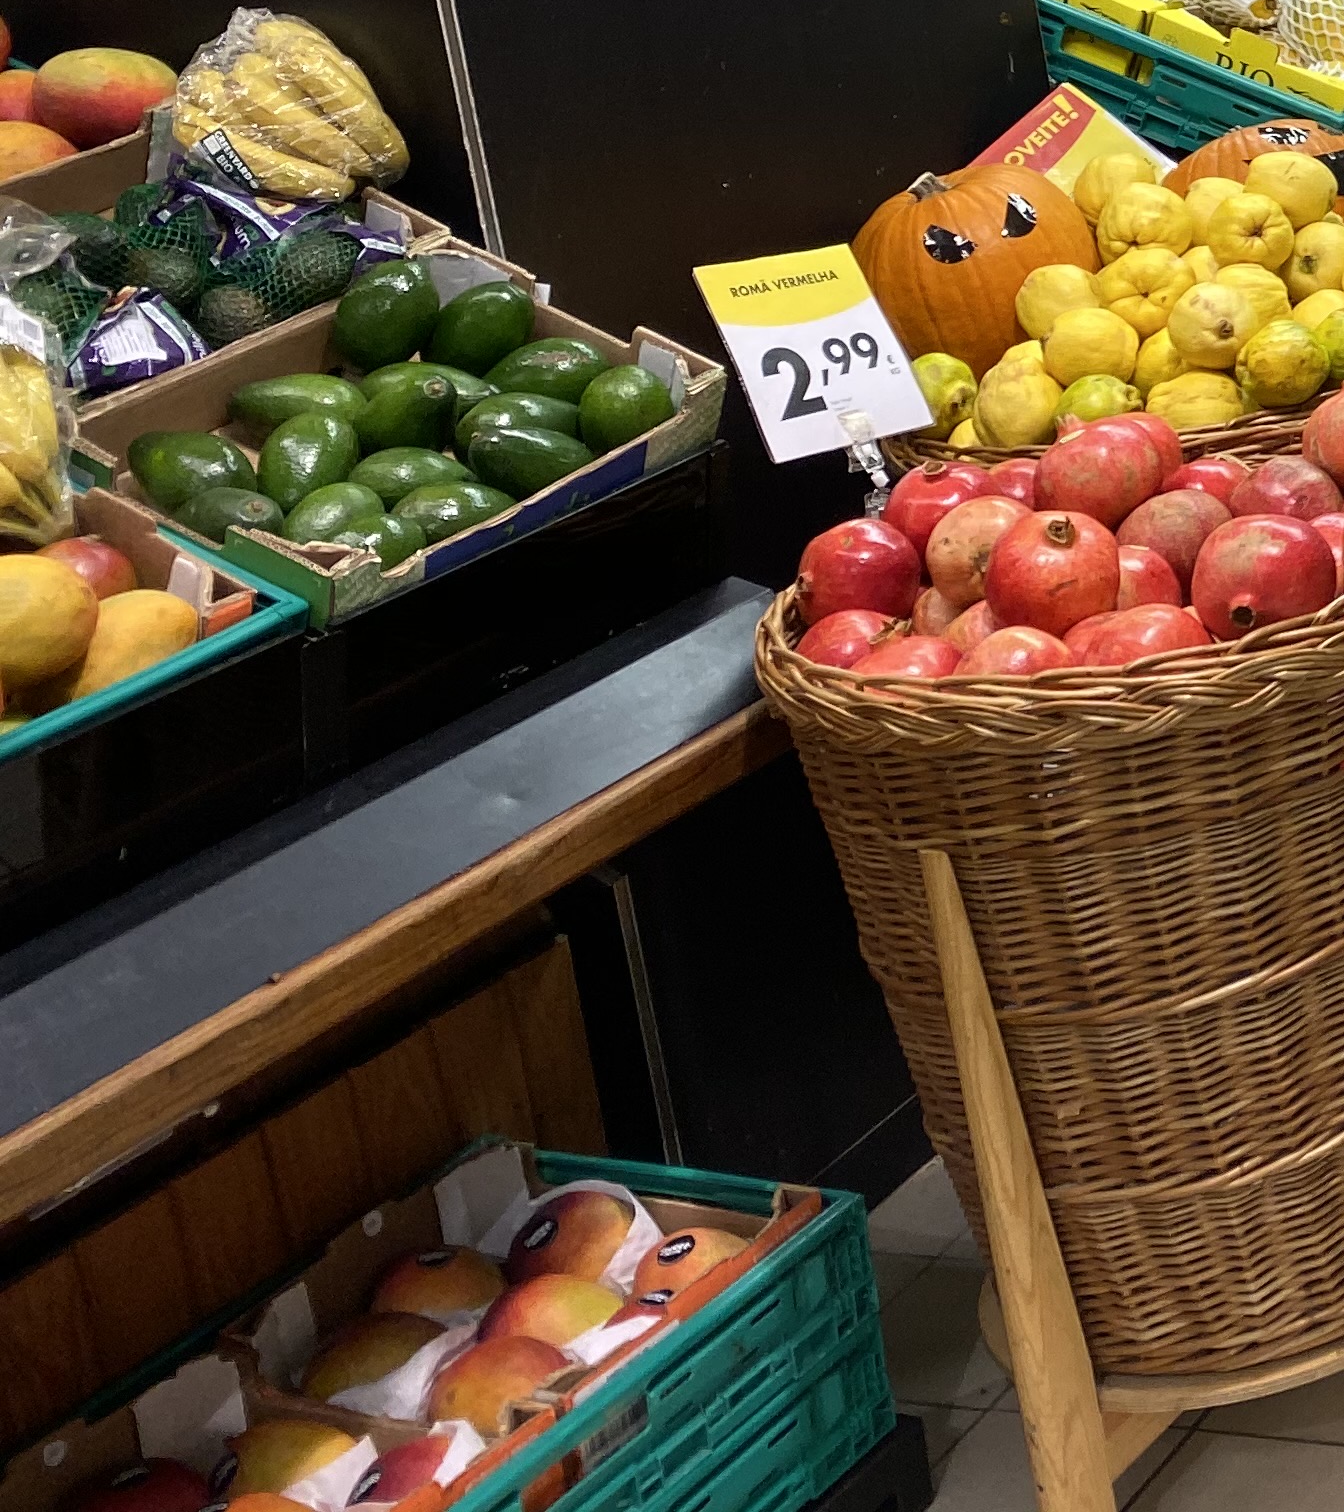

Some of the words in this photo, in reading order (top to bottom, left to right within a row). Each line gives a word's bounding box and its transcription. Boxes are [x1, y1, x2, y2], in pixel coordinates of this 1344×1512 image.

[215, 131, 253, 182] GREENYARD
[216, 154, 234, 174] BIO
[729, 279, 771, 298] ROMÃ
[772, 269, 839, 290] VERMELHA
[761, 332, 879, 421] 2,99
